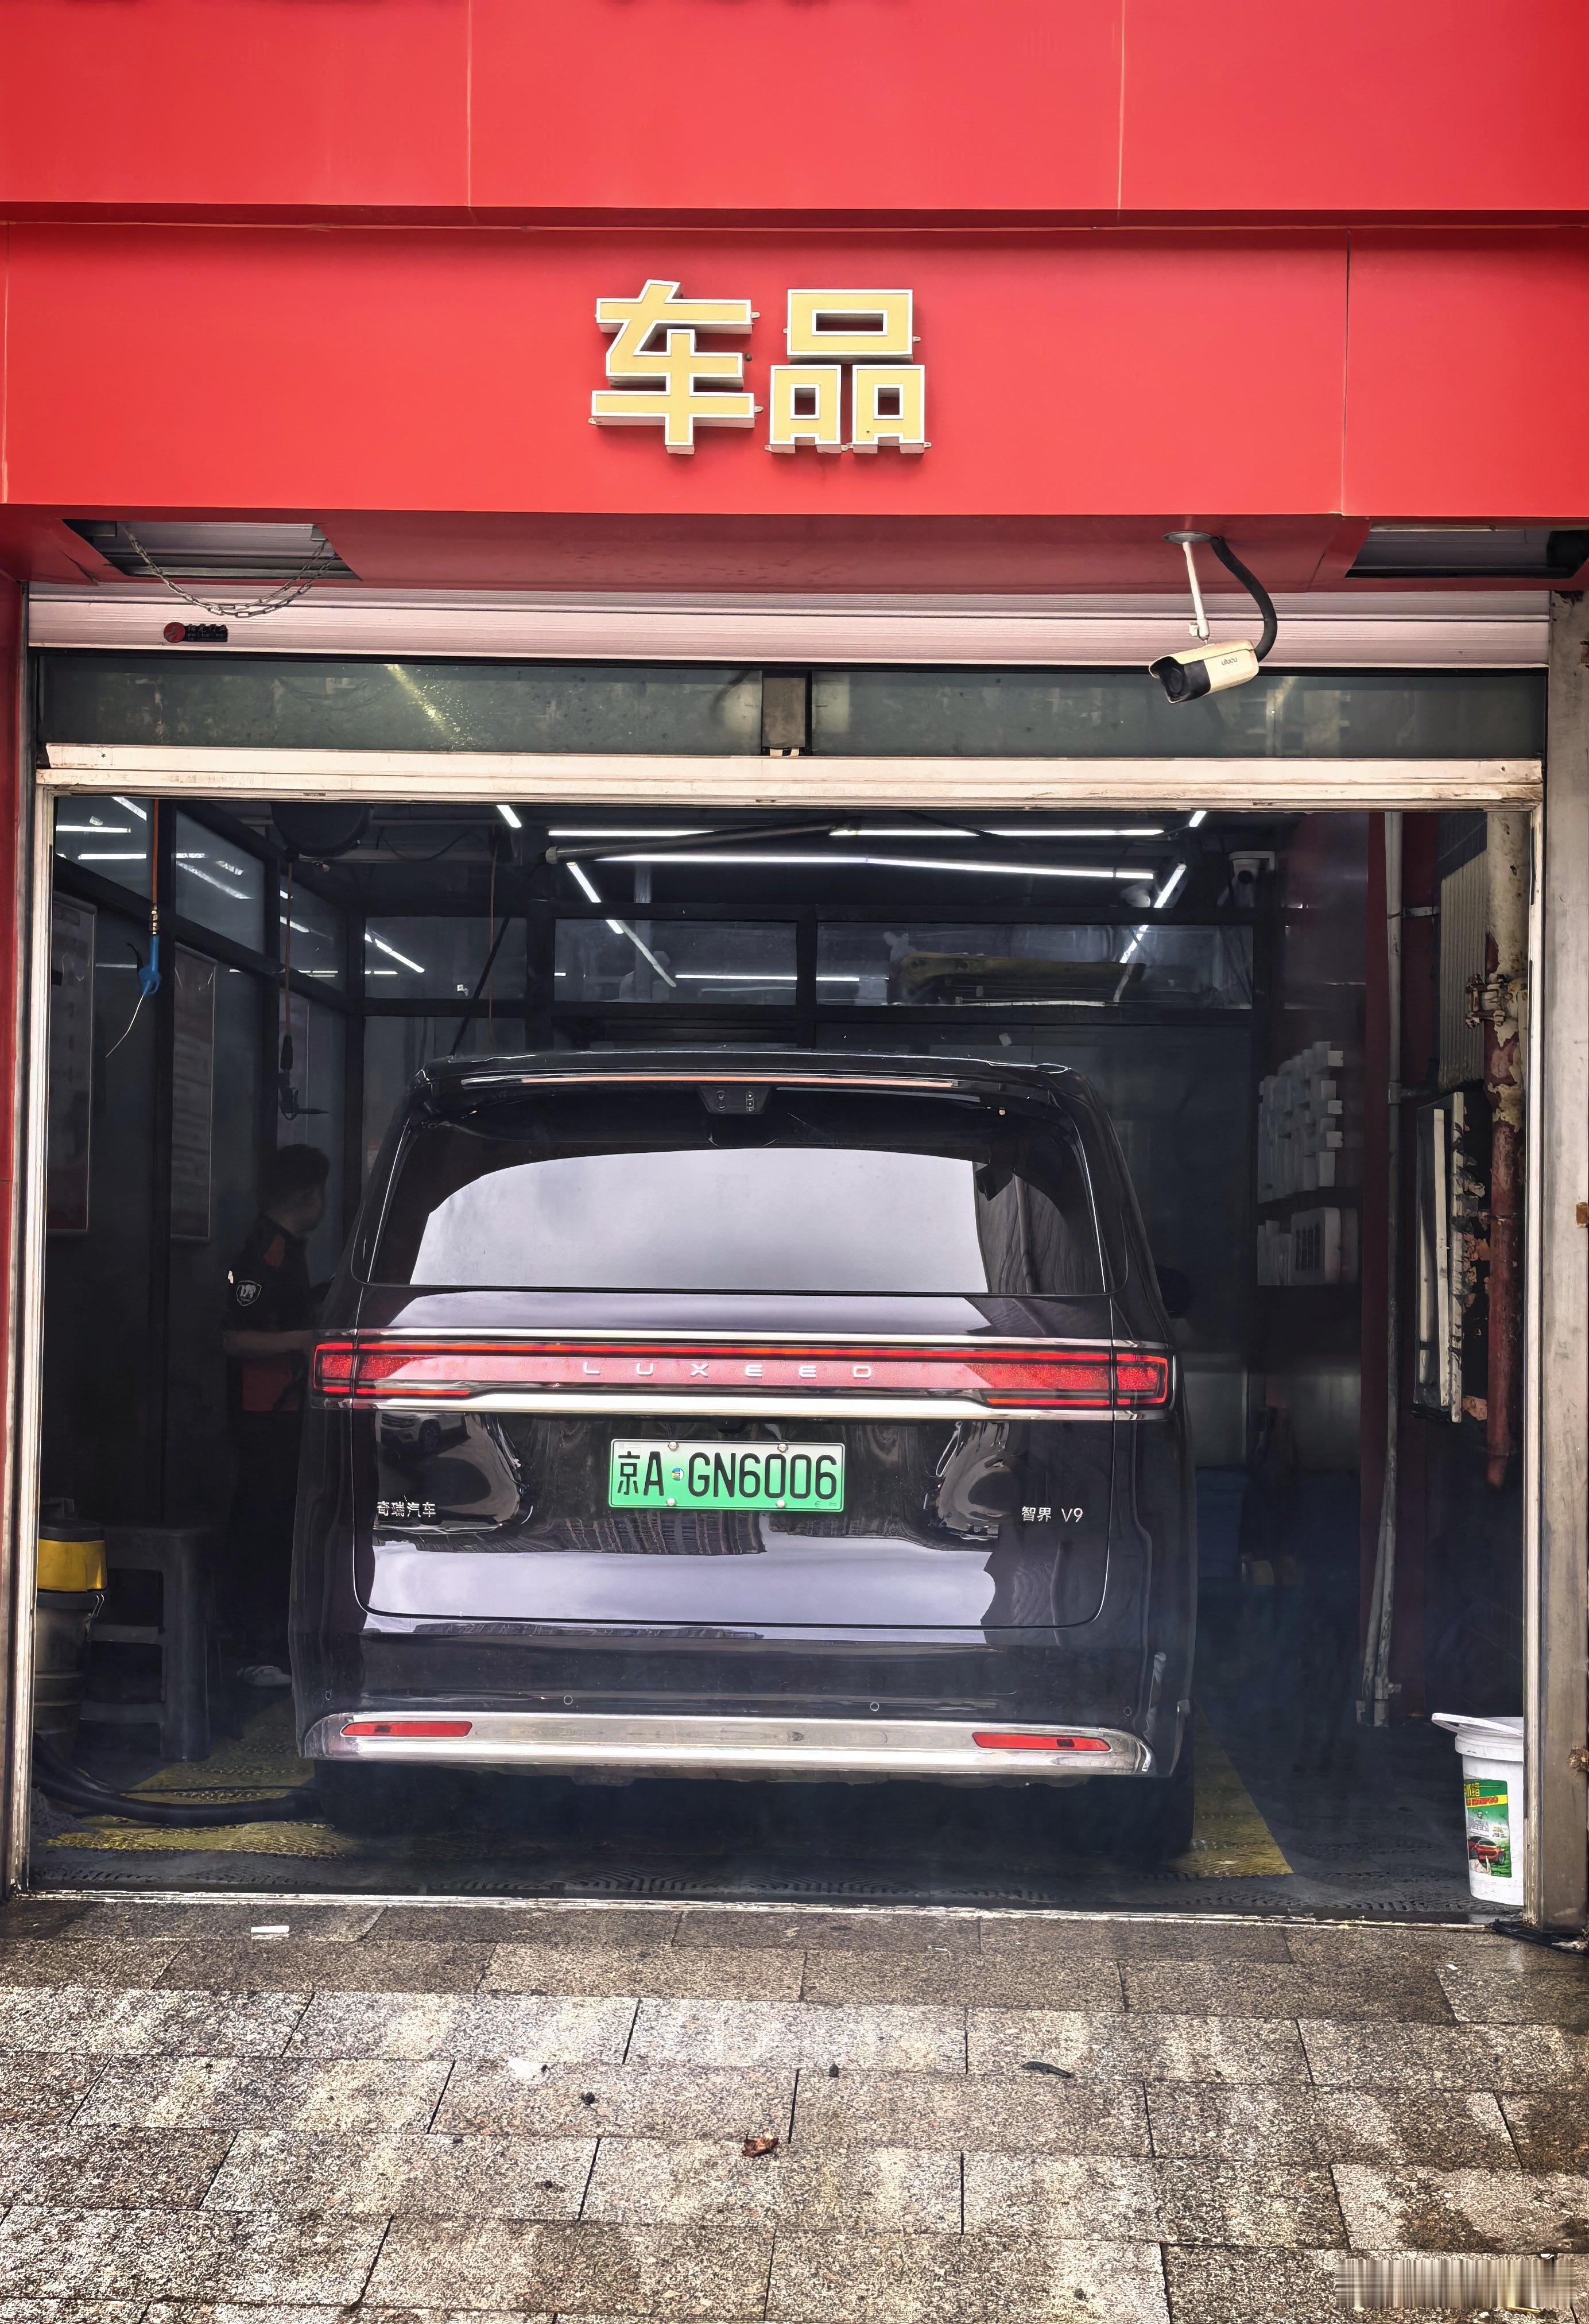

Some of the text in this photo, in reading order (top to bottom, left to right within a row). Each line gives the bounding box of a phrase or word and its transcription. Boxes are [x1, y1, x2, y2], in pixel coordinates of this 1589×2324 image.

[591, 279, 927, 454] 车品
[583, 1361, 872, 1378] LUXEED
[617, 1451, 837, 1500] 京A GN6006
[377, 1500, 436, 1517] 奇瑞汽车
[1022, 1506, 1083, 1523] 智界 V9
